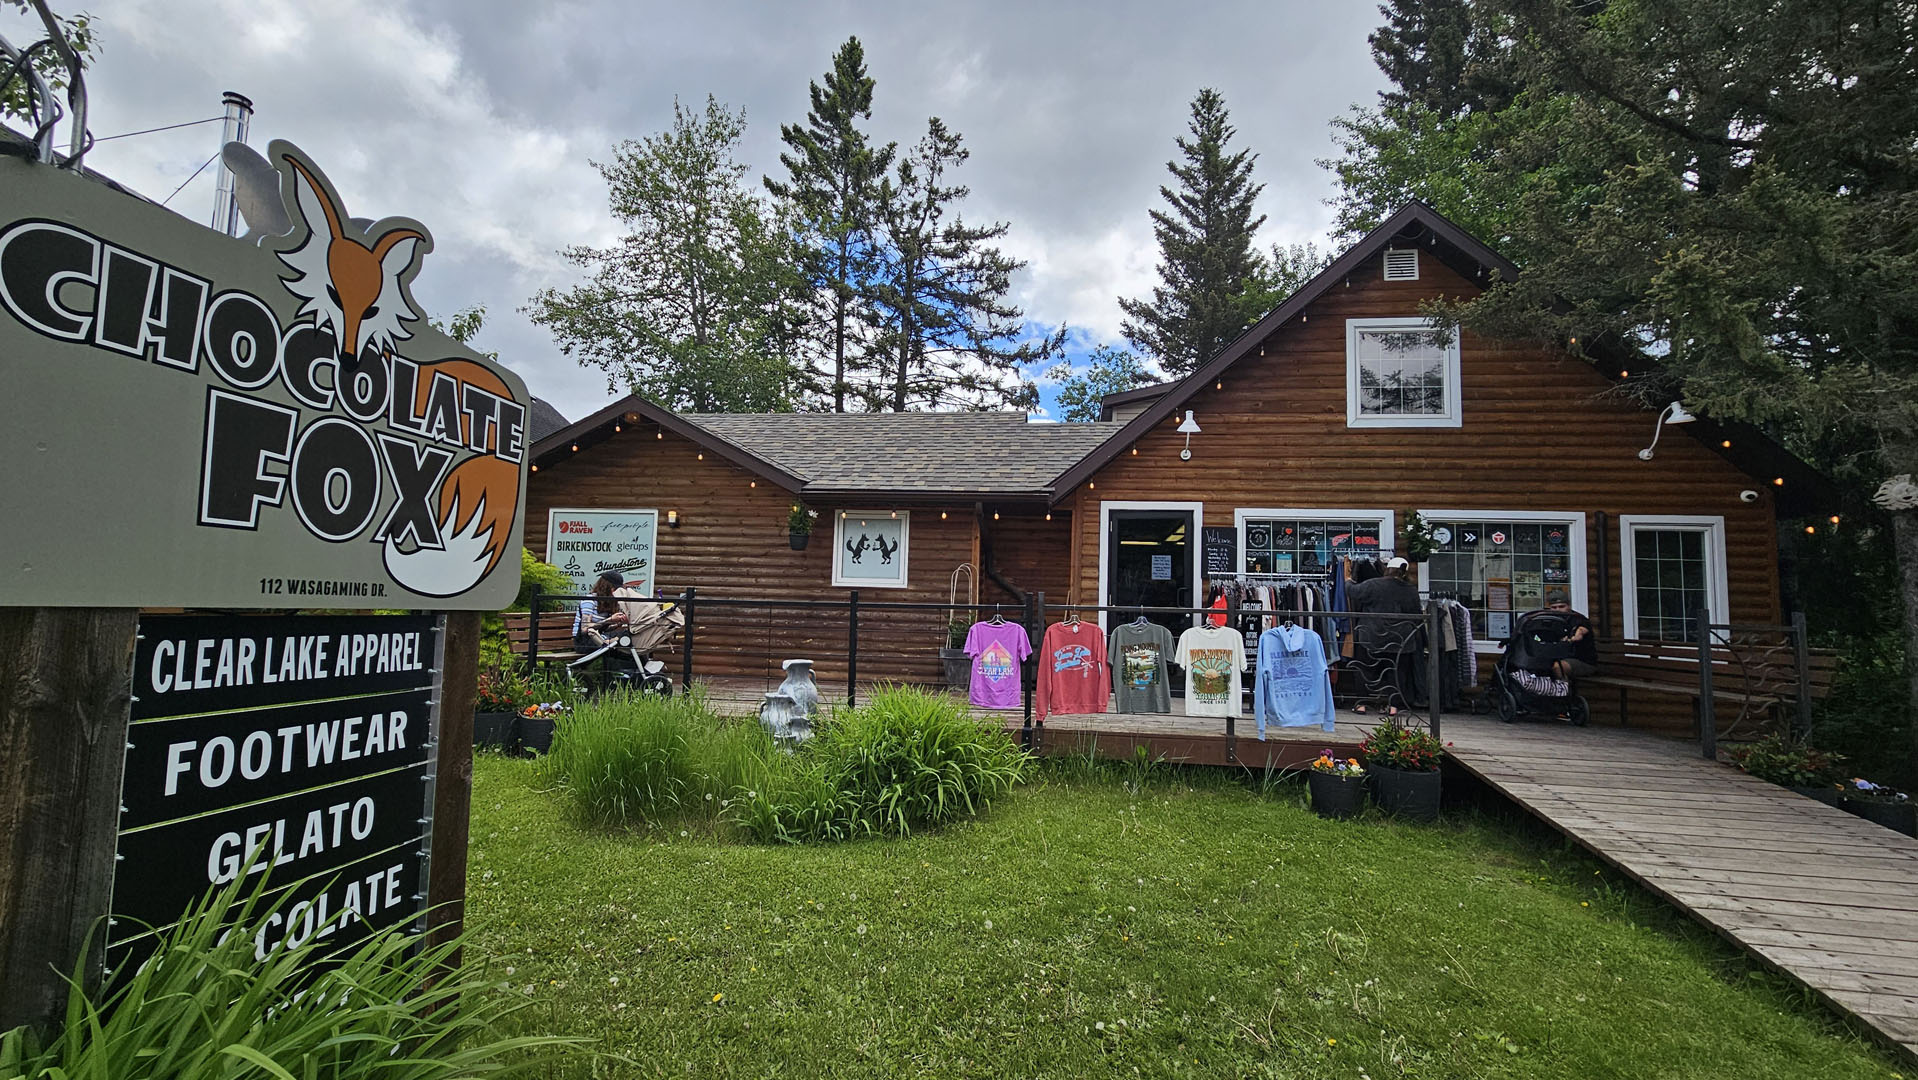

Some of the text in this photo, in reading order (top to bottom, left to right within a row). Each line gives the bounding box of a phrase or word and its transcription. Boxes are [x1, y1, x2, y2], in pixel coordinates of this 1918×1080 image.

[0, 217, 526, 464] CHOCOLATE
[197, 384, 456, 552] FOX
[556, 540, 649, 552] BIRKENSTOCK glerups
[593, 557, 648, 574] Blundstone
[260, 578, 388, 598] 112 WASAGAMING DR.
[151, 632, 423, 693] CLEAR LAKE APPAREL
[164, 710, 408, 797] FOOTWEAR
[207, 796, 375, 885] GELATO
